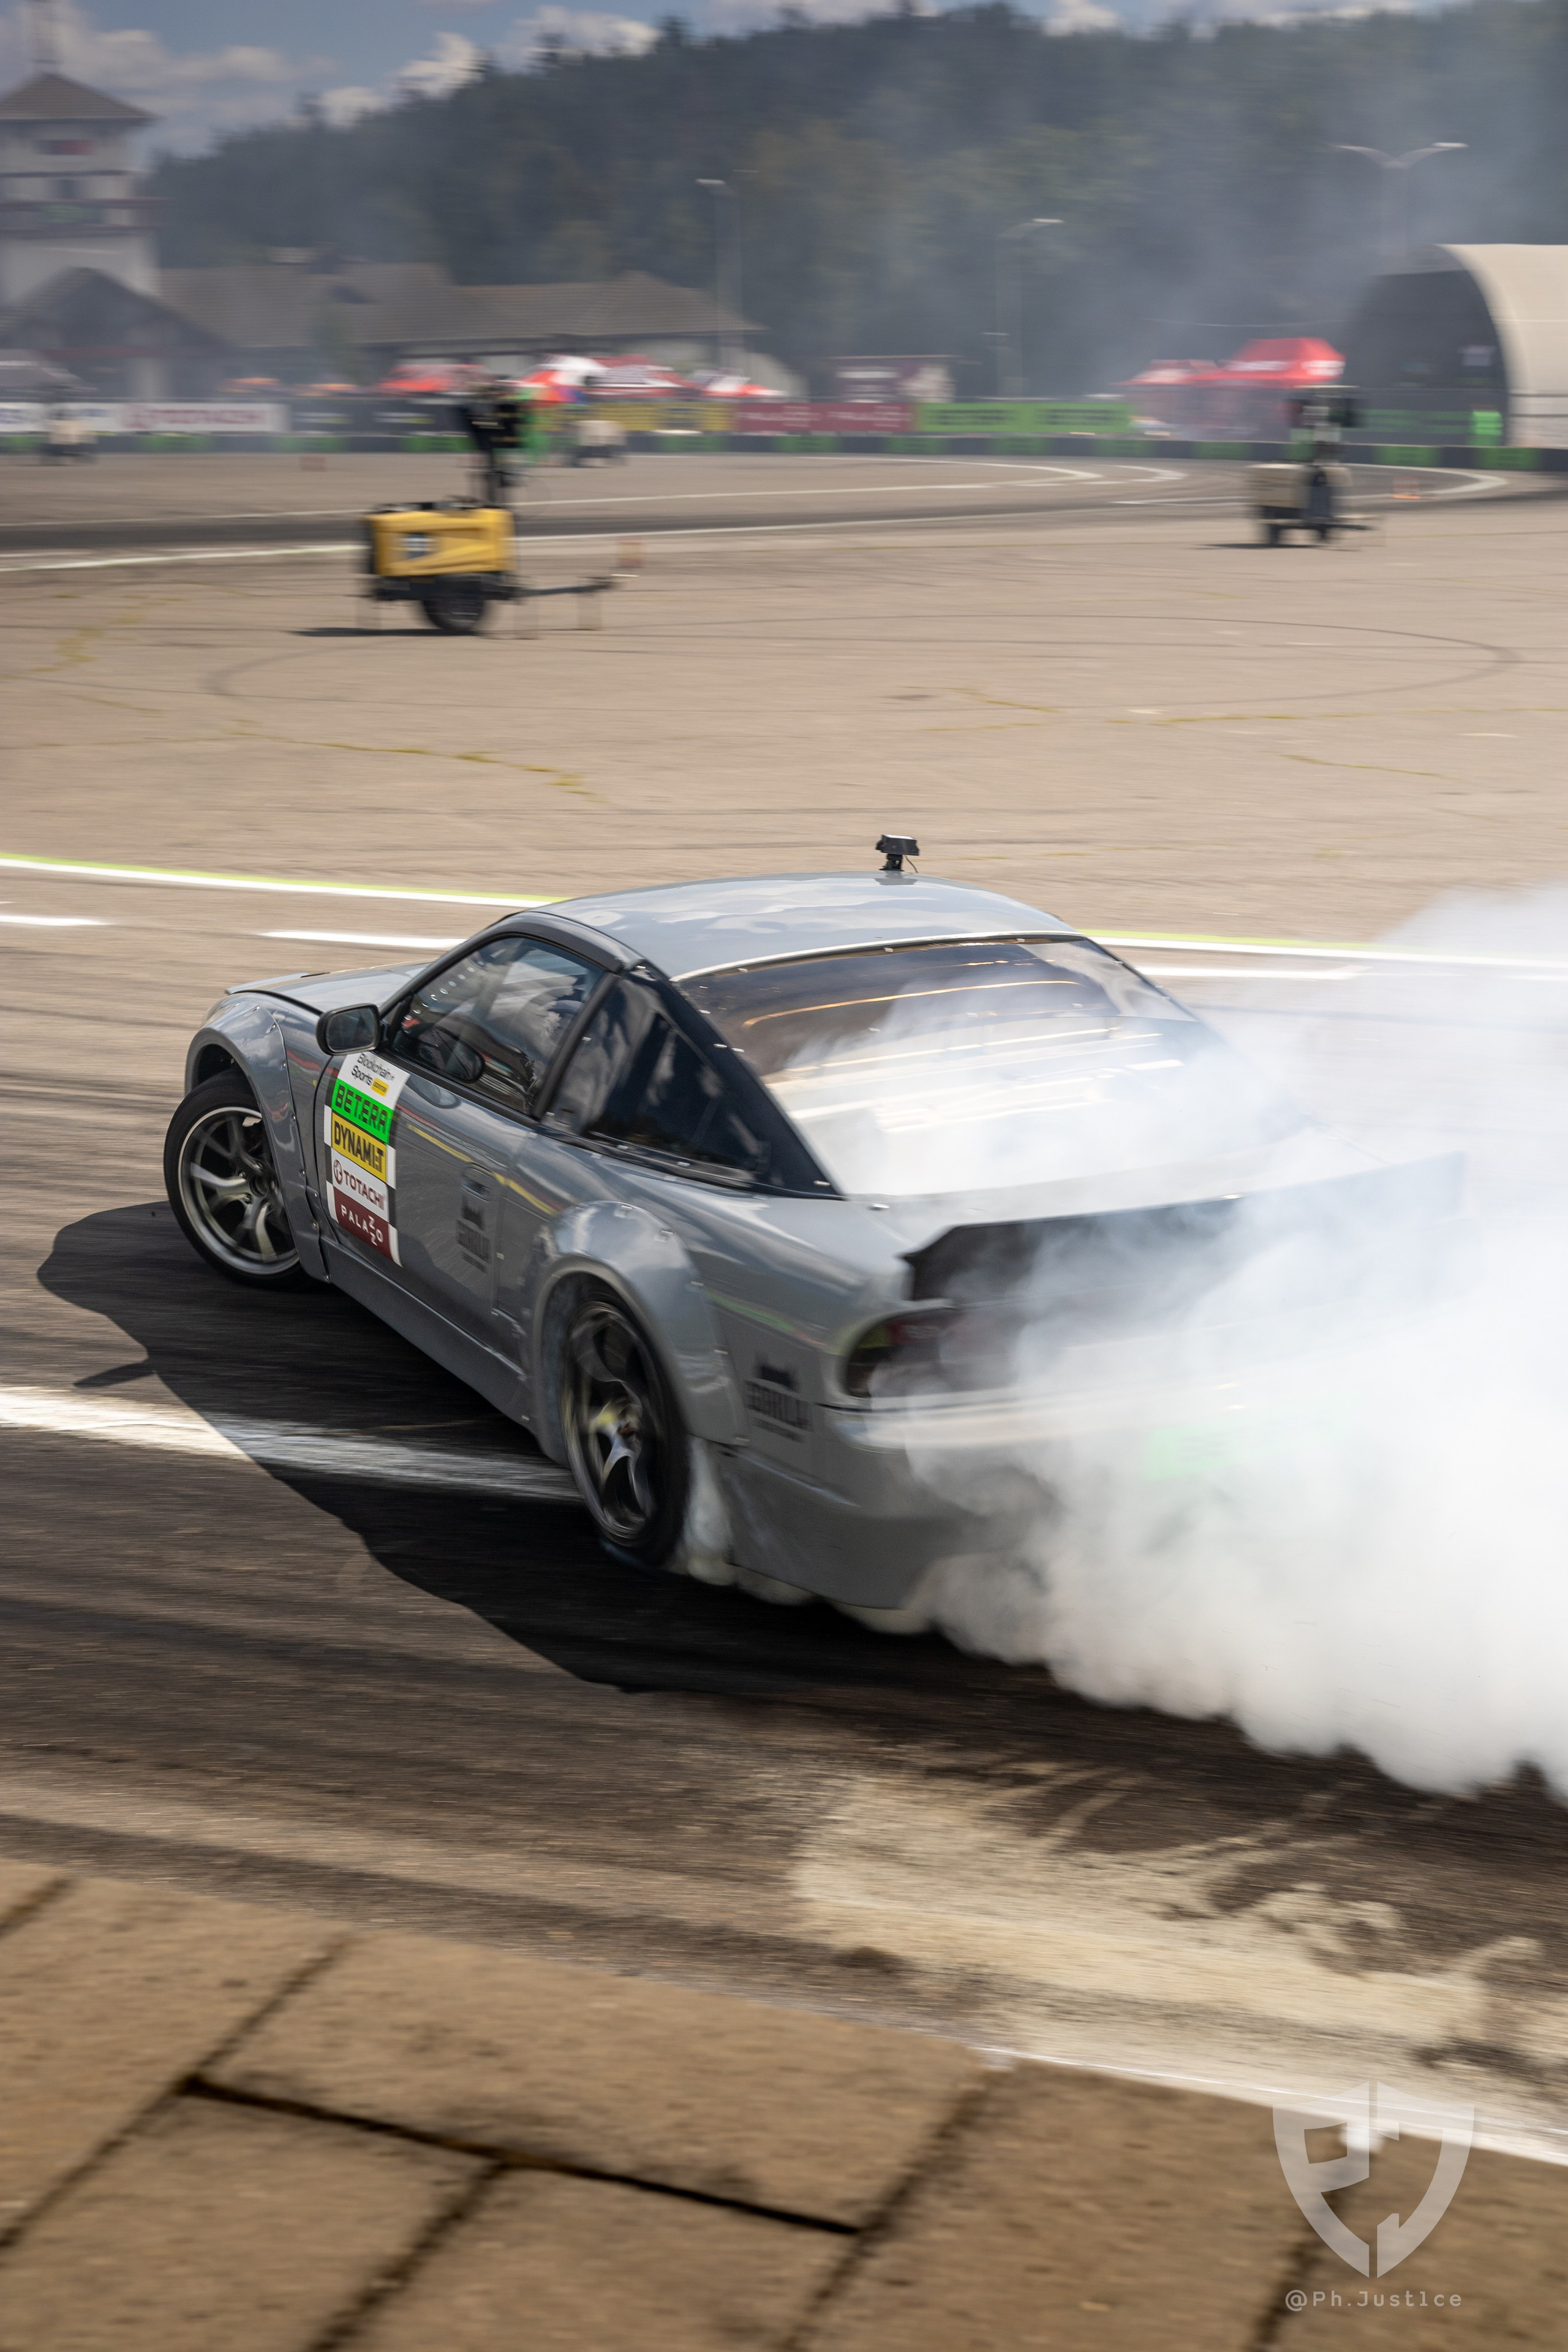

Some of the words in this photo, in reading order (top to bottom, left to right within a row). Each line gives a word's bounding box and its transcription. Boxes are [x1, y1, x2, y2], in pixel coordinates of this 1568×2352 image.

[351, 1065, 373, 1086] Sports
[336, 1084, 388, 1134] BETERA
[342, 1169, 385, 1211] TOTACHI
